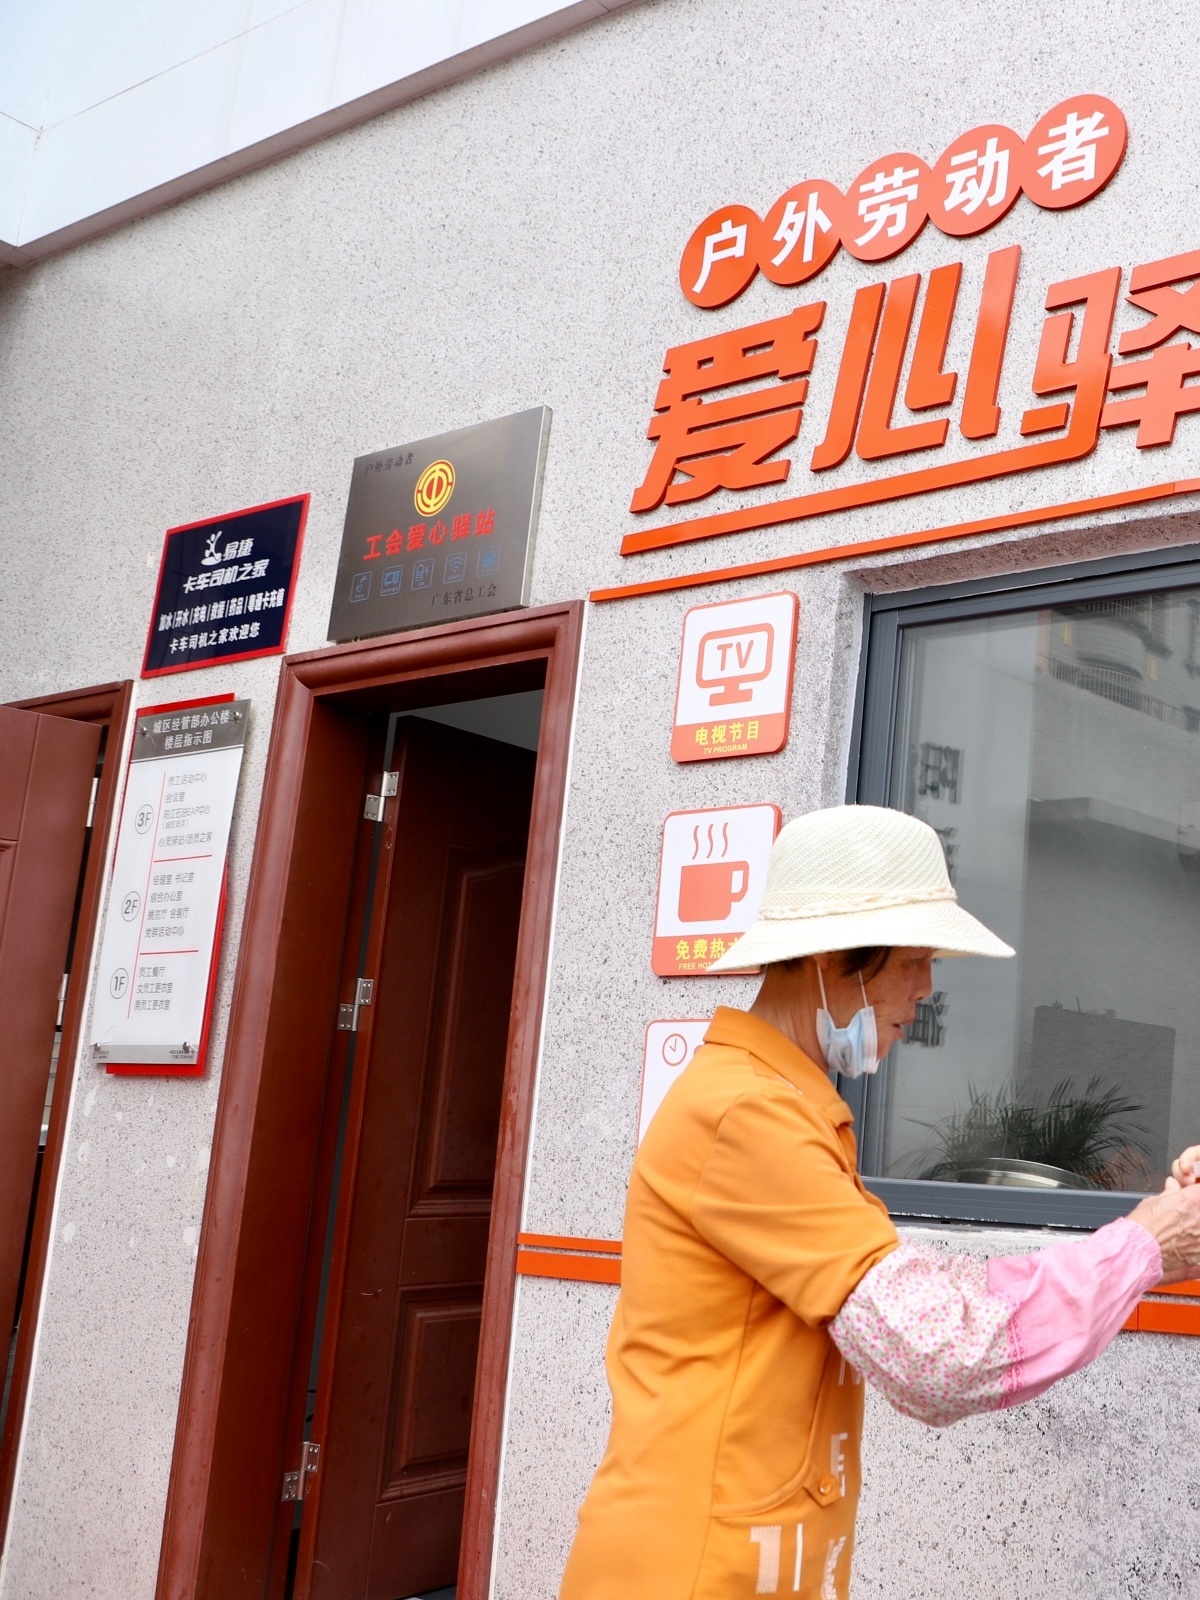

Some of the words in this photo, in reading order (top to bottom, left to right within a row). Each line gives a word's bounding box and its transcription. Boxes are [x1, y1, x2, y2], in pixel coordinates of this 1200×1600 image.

[692, 111, 1109, 293] 户外劳动者
[365, 452, 414, 475] 户外劳动者
[363, 508, 496, 560] 工会爱心驿站
[223, 538, 254, 561] 易捷
[182, 558, 270, 594] 卡车司机之家
[431, 583, 498, 607] 广东省总工会
[169, 622, 261, 654] 卡车司机之家欢迎您
[716, 639, 754, 672] TV
[153, 709, 231, 735] 城区经管部办公楼
[695, 720, 759, 746] 电视节目
[164, 729, 213, 751] 楼层指示图
[703, 747, 712, 755] TV
[713, 743, 748, 754] PROGRAM
[137, 811, 152, 828] 3F
[123, 899, 139, 915] 2F
[678, 962, 697, 970] FREE
[697, 961, 711, 969] HOT
[114, 976, 126, 991] 1F
